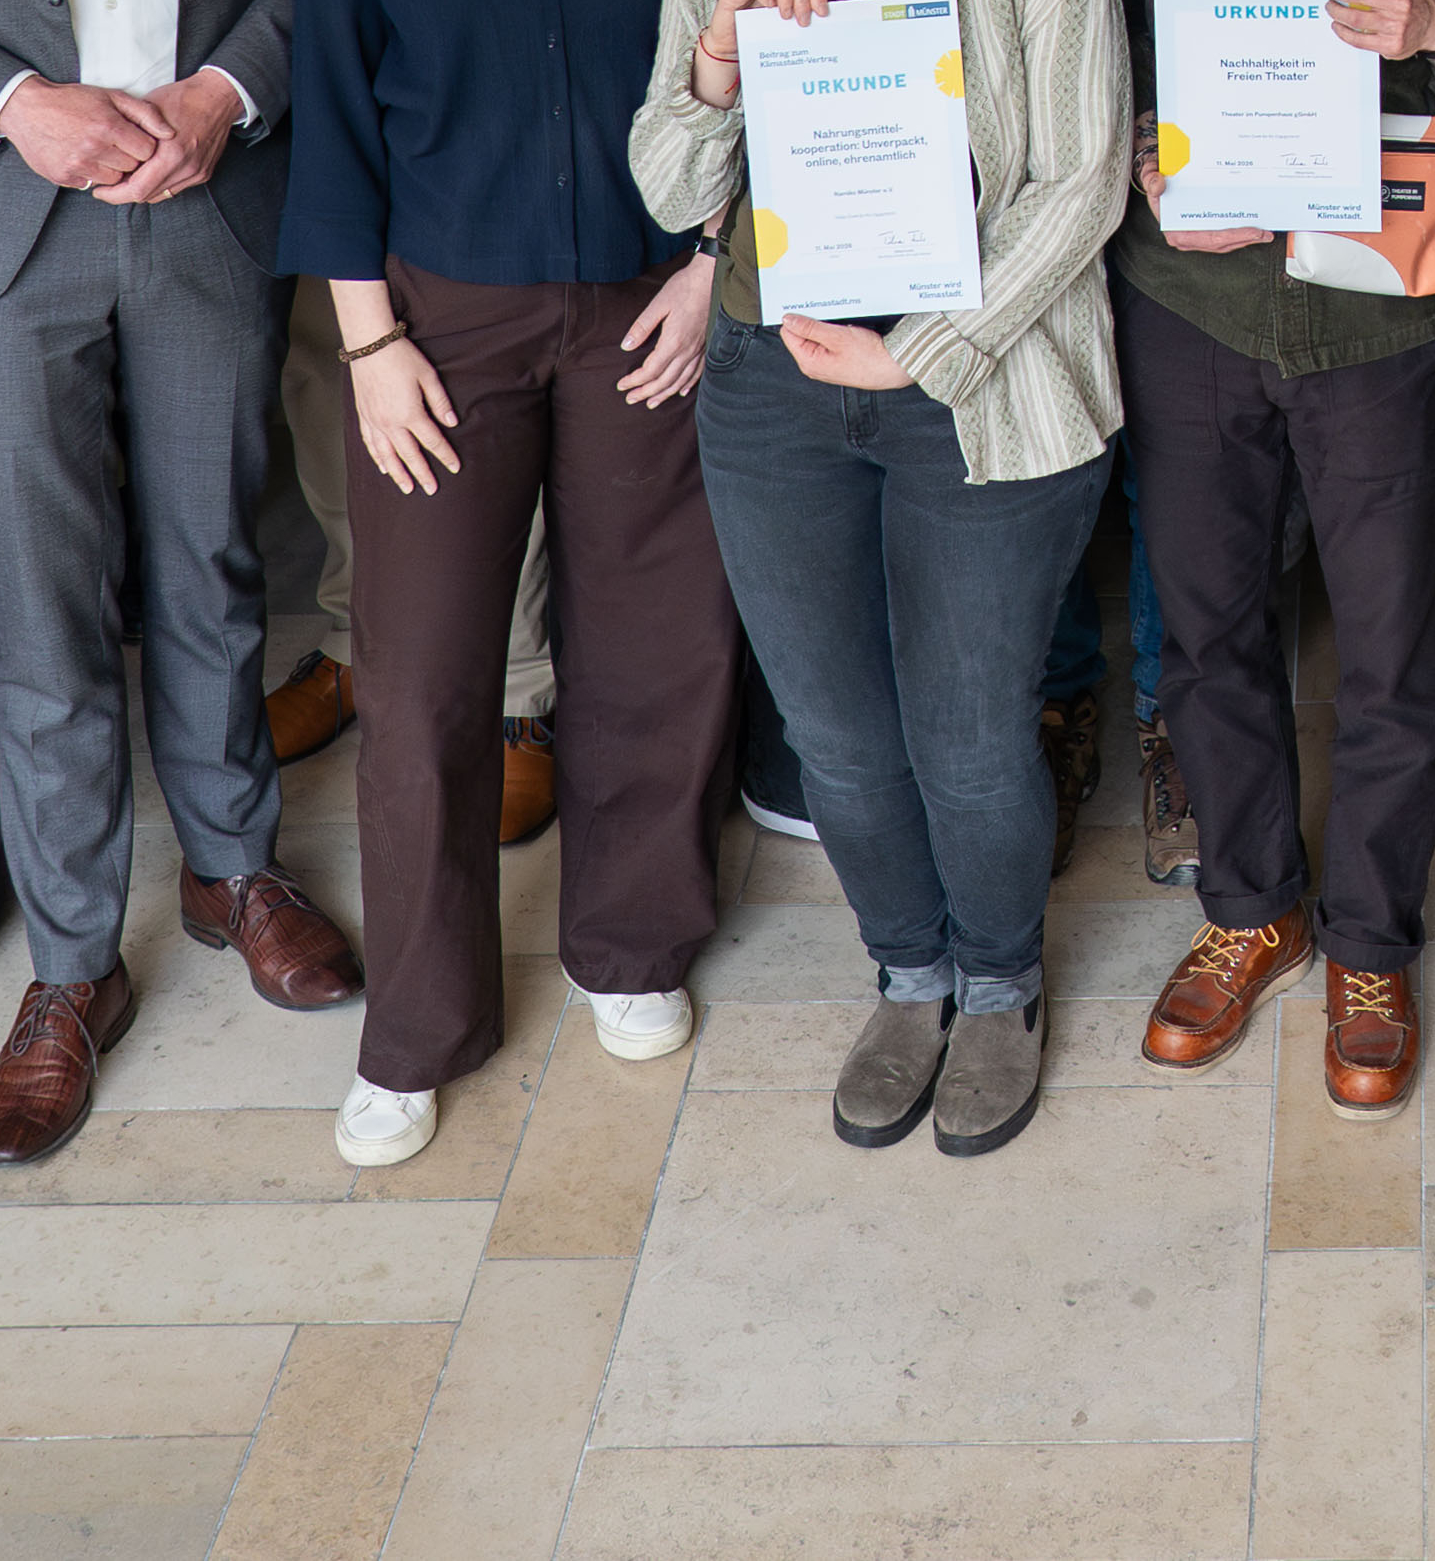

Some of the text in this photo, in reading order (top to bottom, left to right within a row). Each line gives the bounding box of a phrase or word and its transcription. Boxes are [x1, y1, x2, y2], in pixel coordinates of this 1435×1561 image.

[916, 5, 949, 16] MÜNSTER
[1215, 5, 1320, 19] URKUNDE
[760, 50, 789, 60] Beitrag
[760, 54, 838, 68] Klimastadt-Vertrag
[1220, 58, 1315, 70] Nachhaltigkeit im
[1227, 71, 1308, 81] Freien Theater
[802, 74, 907, 95] URKUNDE
[814, 125, 903, 140] Nahrungsmittel-
[791, 136, 928, 155] kooperation: Unverpackt,
[806, 150, 916, 167] online, ehrenamtlich
[1308, 203, 1362, 211] Münster wird
[1180, 211, 1258, 220] www.klimastadt.ms
[909, 280, 961, 291] Münster wird
[783, 297, 861, 311] www.klimastadt.ms
